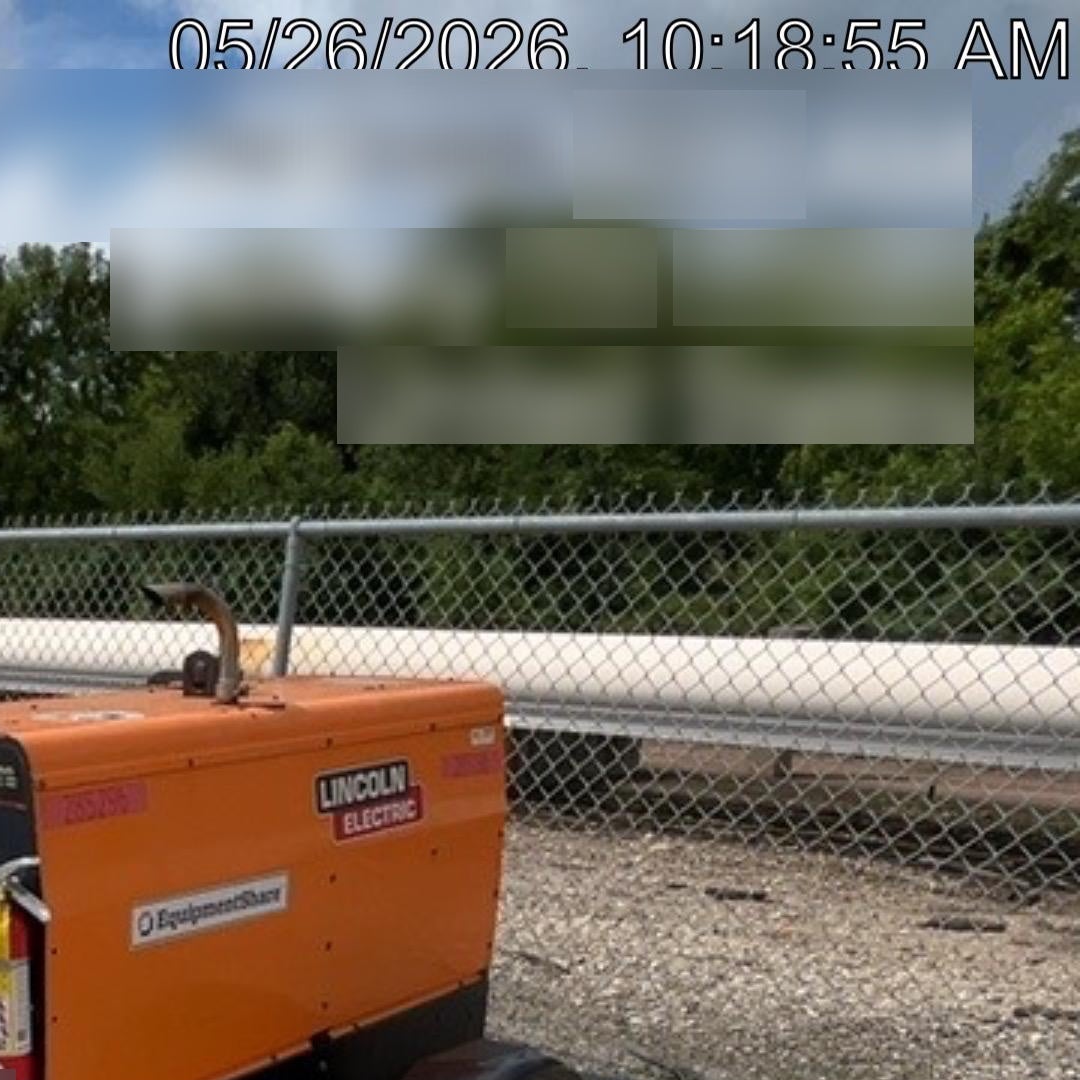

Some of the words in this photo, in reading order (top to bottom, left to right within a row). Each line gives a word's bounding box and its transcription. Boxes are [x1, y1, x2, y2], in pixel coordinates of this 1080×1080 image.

[320, 764, 406, 808] LINCOLN
[344, 799, 417, 835] ELECTRIC
[157, 887, 281, 930] EquipmentShare
